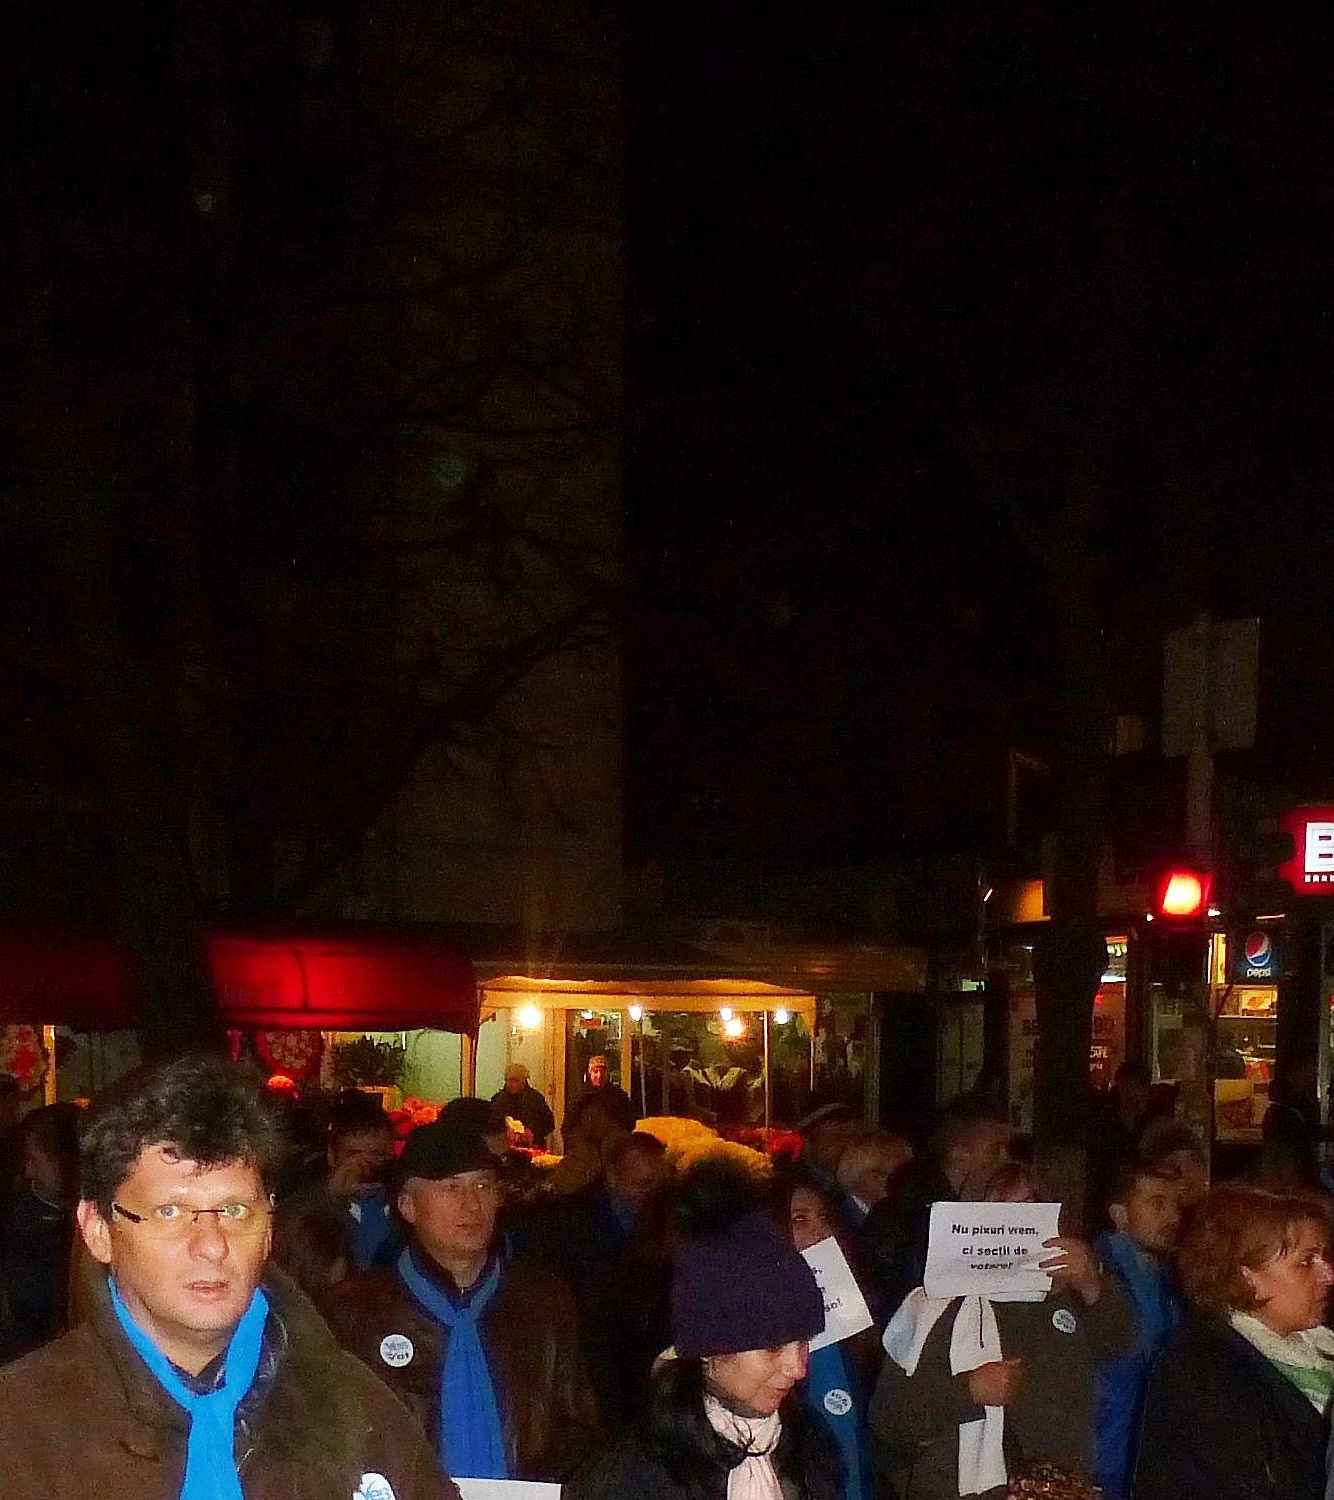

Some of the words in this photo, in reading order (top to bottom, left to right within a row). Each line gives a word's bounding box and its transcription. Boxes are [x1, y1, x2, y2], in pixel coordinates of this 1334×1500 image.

[951, 1224, 969, 1235] Nu
[972, 1225, 1005, 1237] pixuri
[962, 1246, 974, 1256] ci
